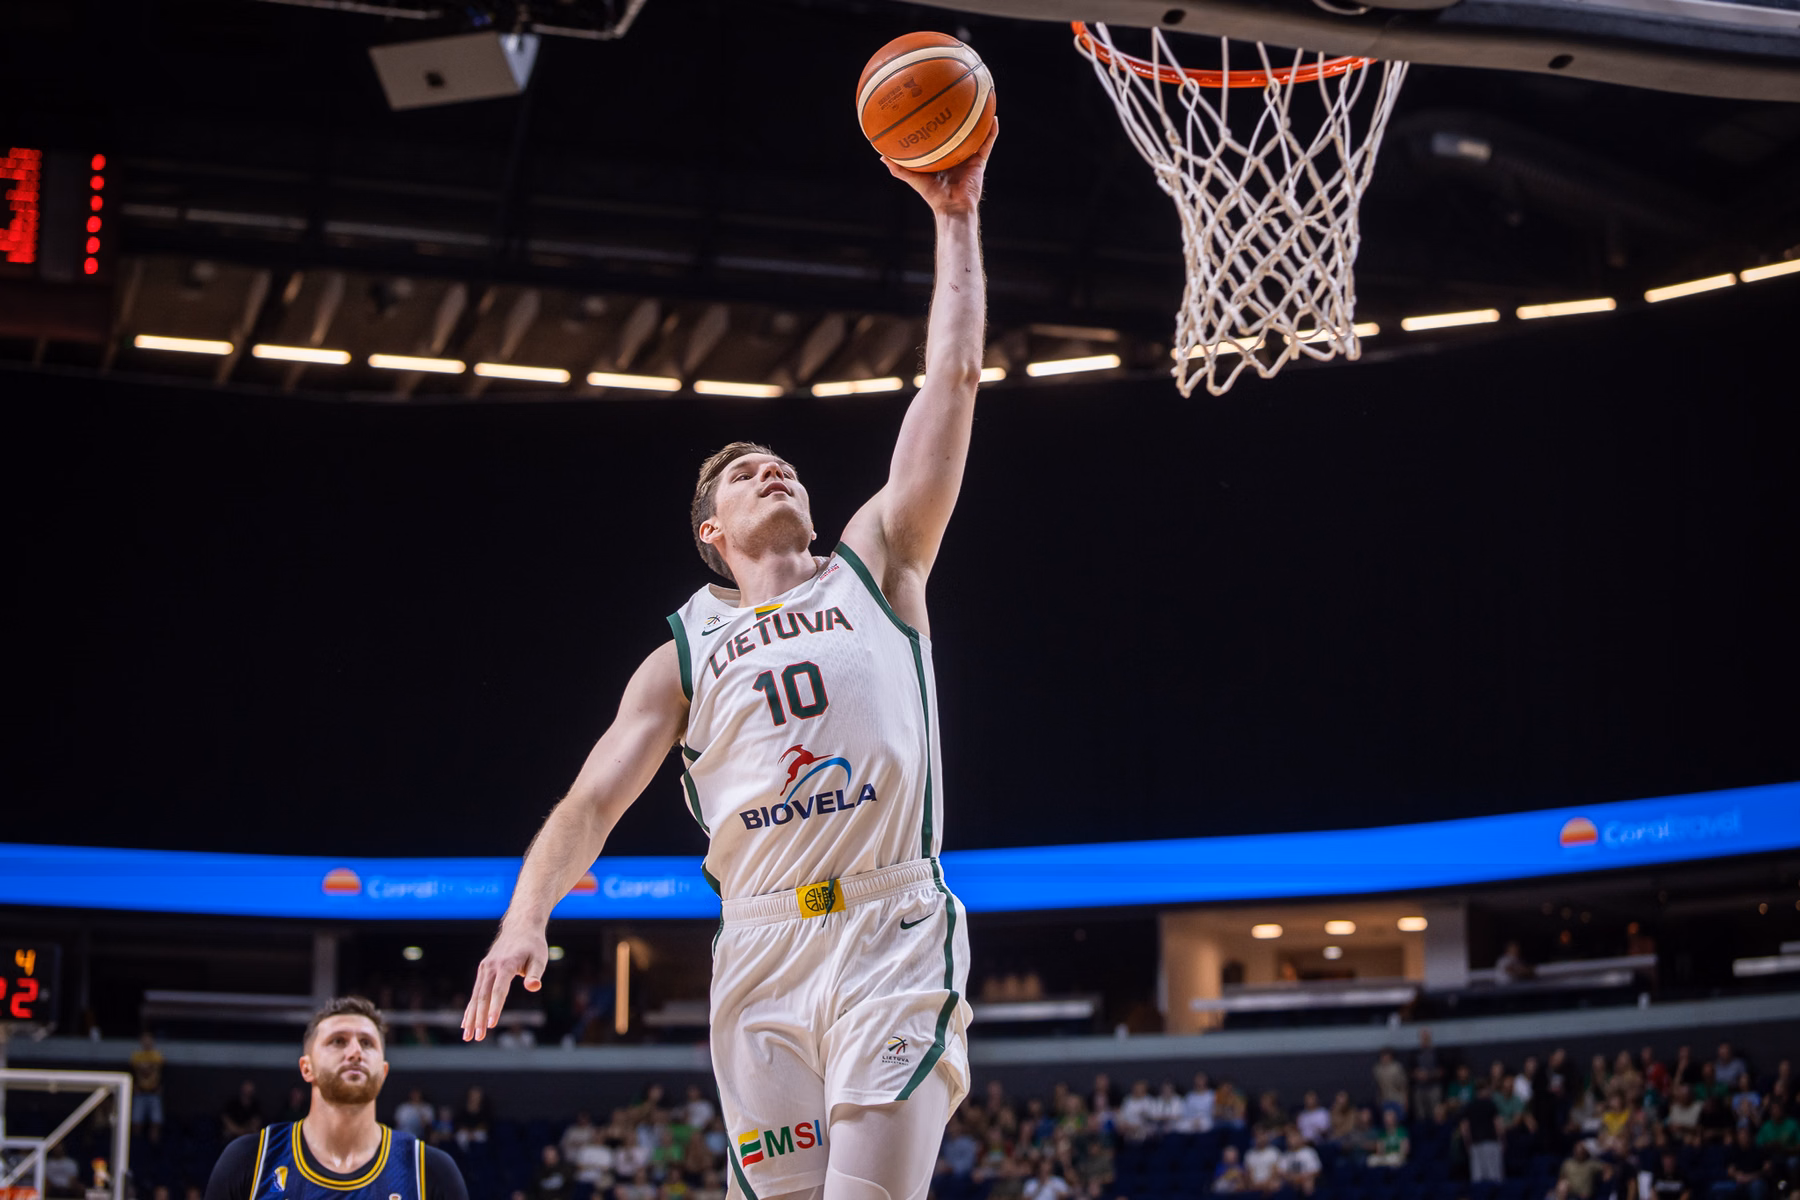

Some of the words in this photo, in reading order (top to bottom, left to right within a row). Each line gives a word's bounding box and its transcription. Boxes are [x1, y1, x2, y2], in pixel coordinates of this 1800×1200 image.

[898, 107, 952, 148] molten
[708, 606, 855, 680] LIETUVA
[752, 660, 829, 726] 10
[739, 783, 878, 830] BIOVELA
[15, 948, 37, 976] 4
[0, 976, 39, 1018] 2
[881, 1055, 910, 1063] LIETUVA
